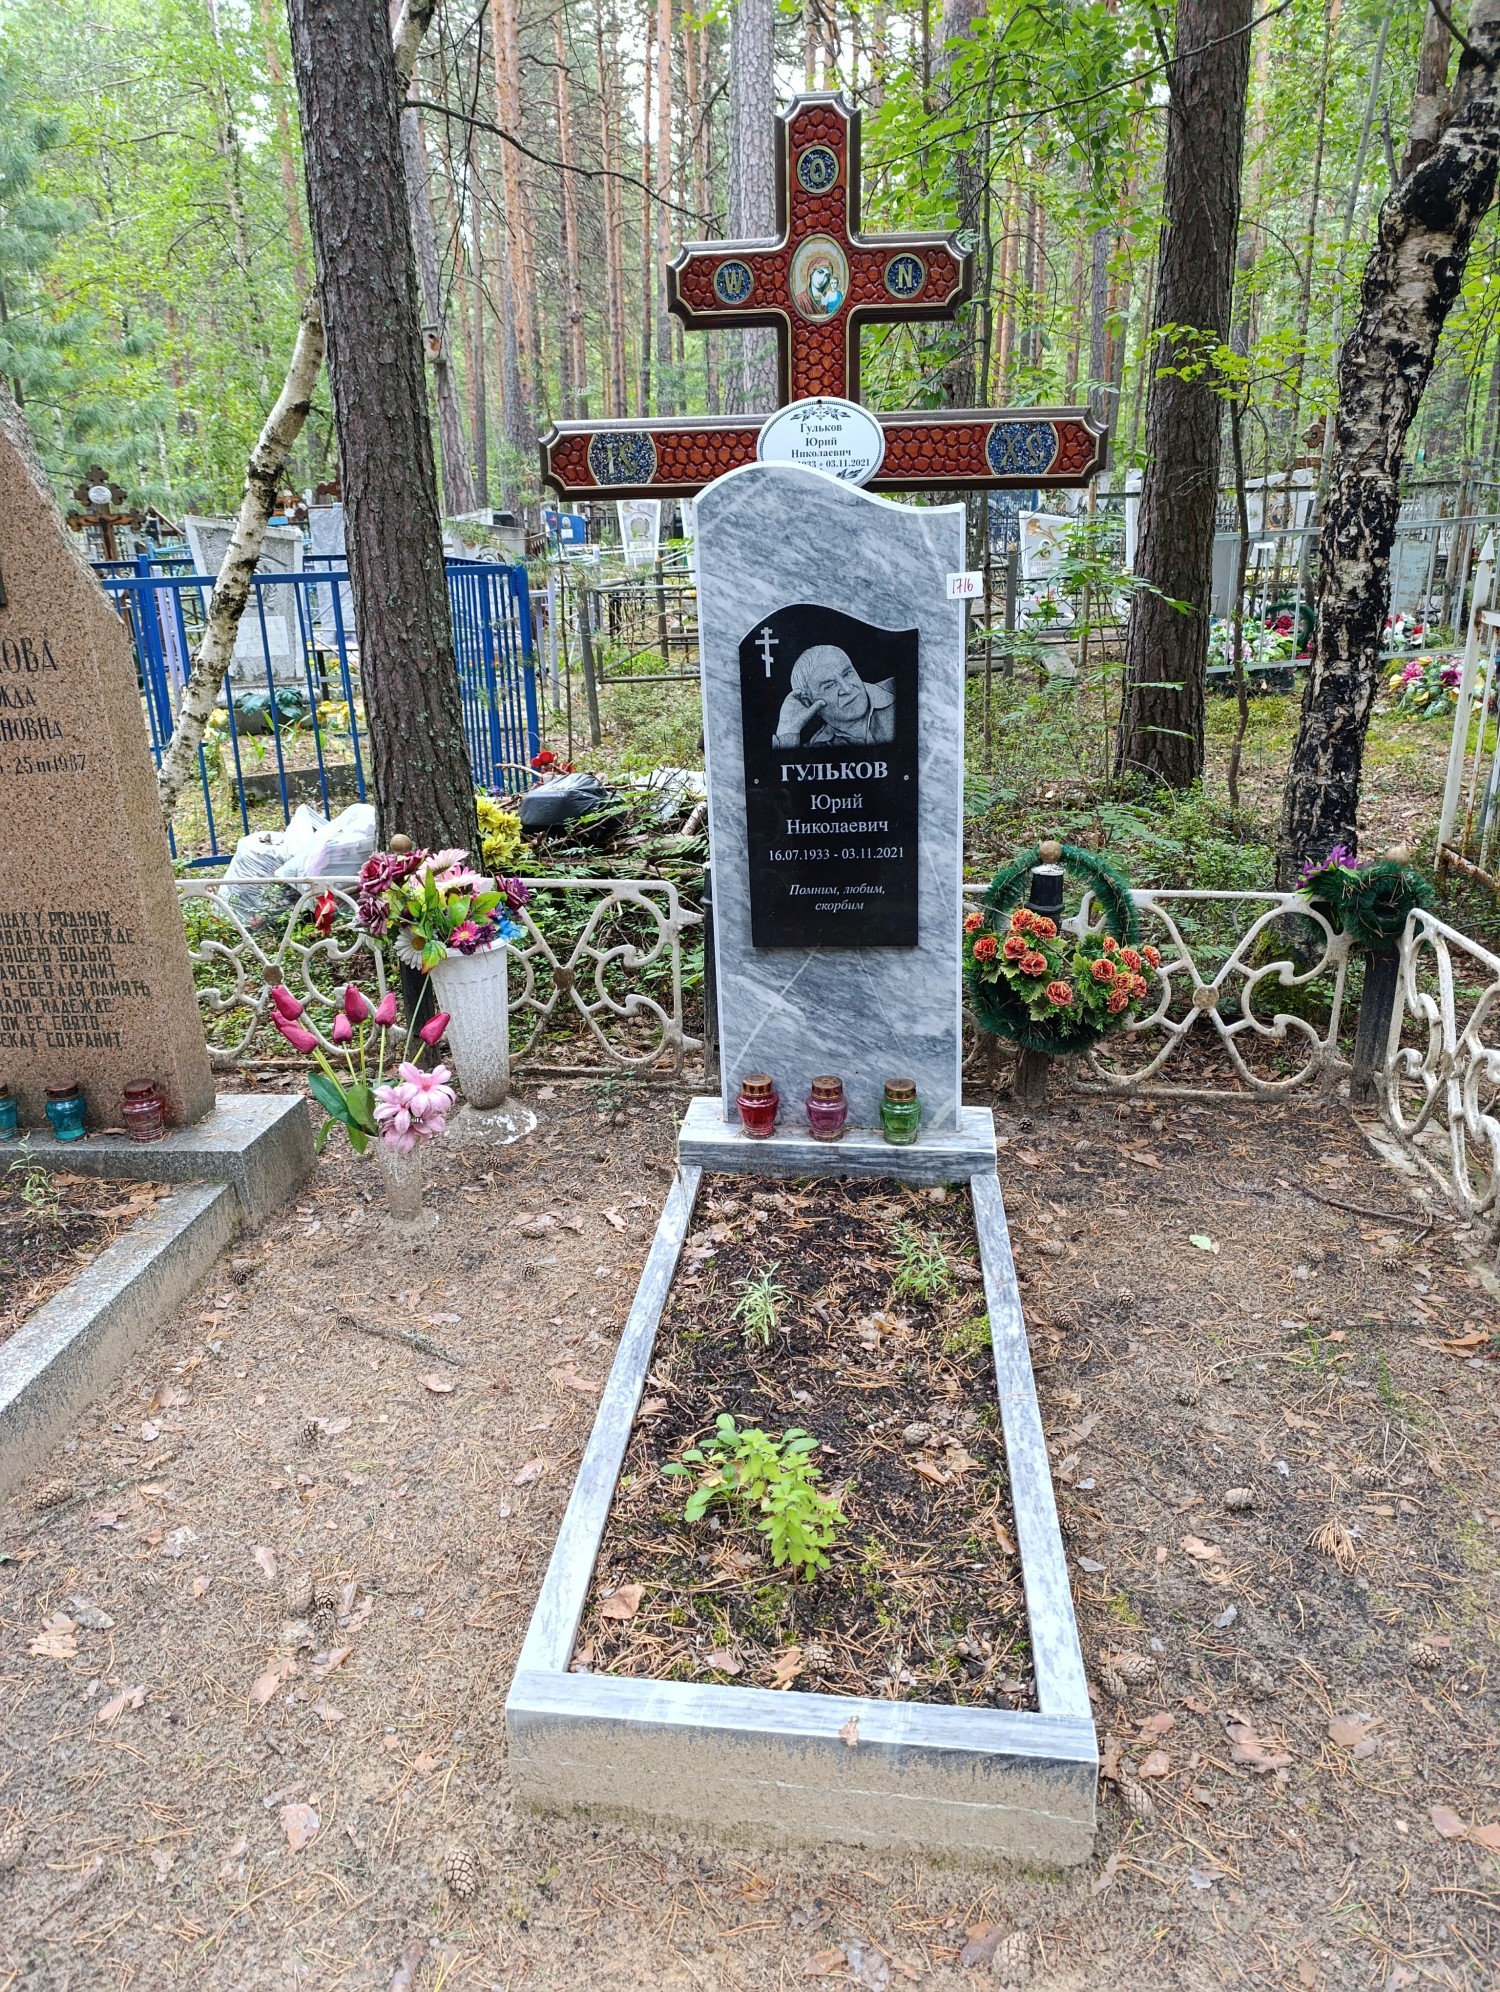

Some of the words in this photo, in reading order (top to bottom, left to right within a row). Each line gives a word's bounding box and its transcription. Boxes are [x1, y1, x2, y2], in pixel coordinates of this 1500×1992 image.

[800, 422, 843, 435] Гульков
[805, 436, 837, 449] Юрий
[791, 448, 852, 459] Николаевич
[825, 458, 870, 469] 03.11.2021
[951, 577, 974, 595] 1716
[0, 637, 58, 674] ОВА
[0, 717, 63, 742] НОВНА
[780, 760, 889, 782] ГУЛЬКОВ
[810, 793, 864, 814] Юрий
[786, 819, 890, 835] Николаевич
[769, 848, 830, 861] 16.07.1933
[841, 846, 904, 860] 03.11.2021
[789, 884, 840, 896] Помним,
[842, 882, 886, 896] любим,
[815, 899, 865, 914] скорбим
[0, 911, 30, 928] ЦАХ
[49, 910, 113, 928] РОДНЫХ
[38, 928, 67, 945] КАК
[71, 928, 136, 945] ПРЕЖДЕ
[60, 946, 112, 963] БОЛЬЮ
[43, 964, 53, 980] В
[60, 963, 117, 979] ГРАНИТ
[18, 981, 85, 997] СВЕТЛАЯ
[90, 980, 150, 997] ПАМЯТЬ
[41, 998, 113, 1014] НАДЕЖДЕ
[26, 1015, 47, 1031] ЕЕ
[52, 1015, 100, 1031] СВЯТО
[46, 1031, 121, 1048] СОХРАНИТ
